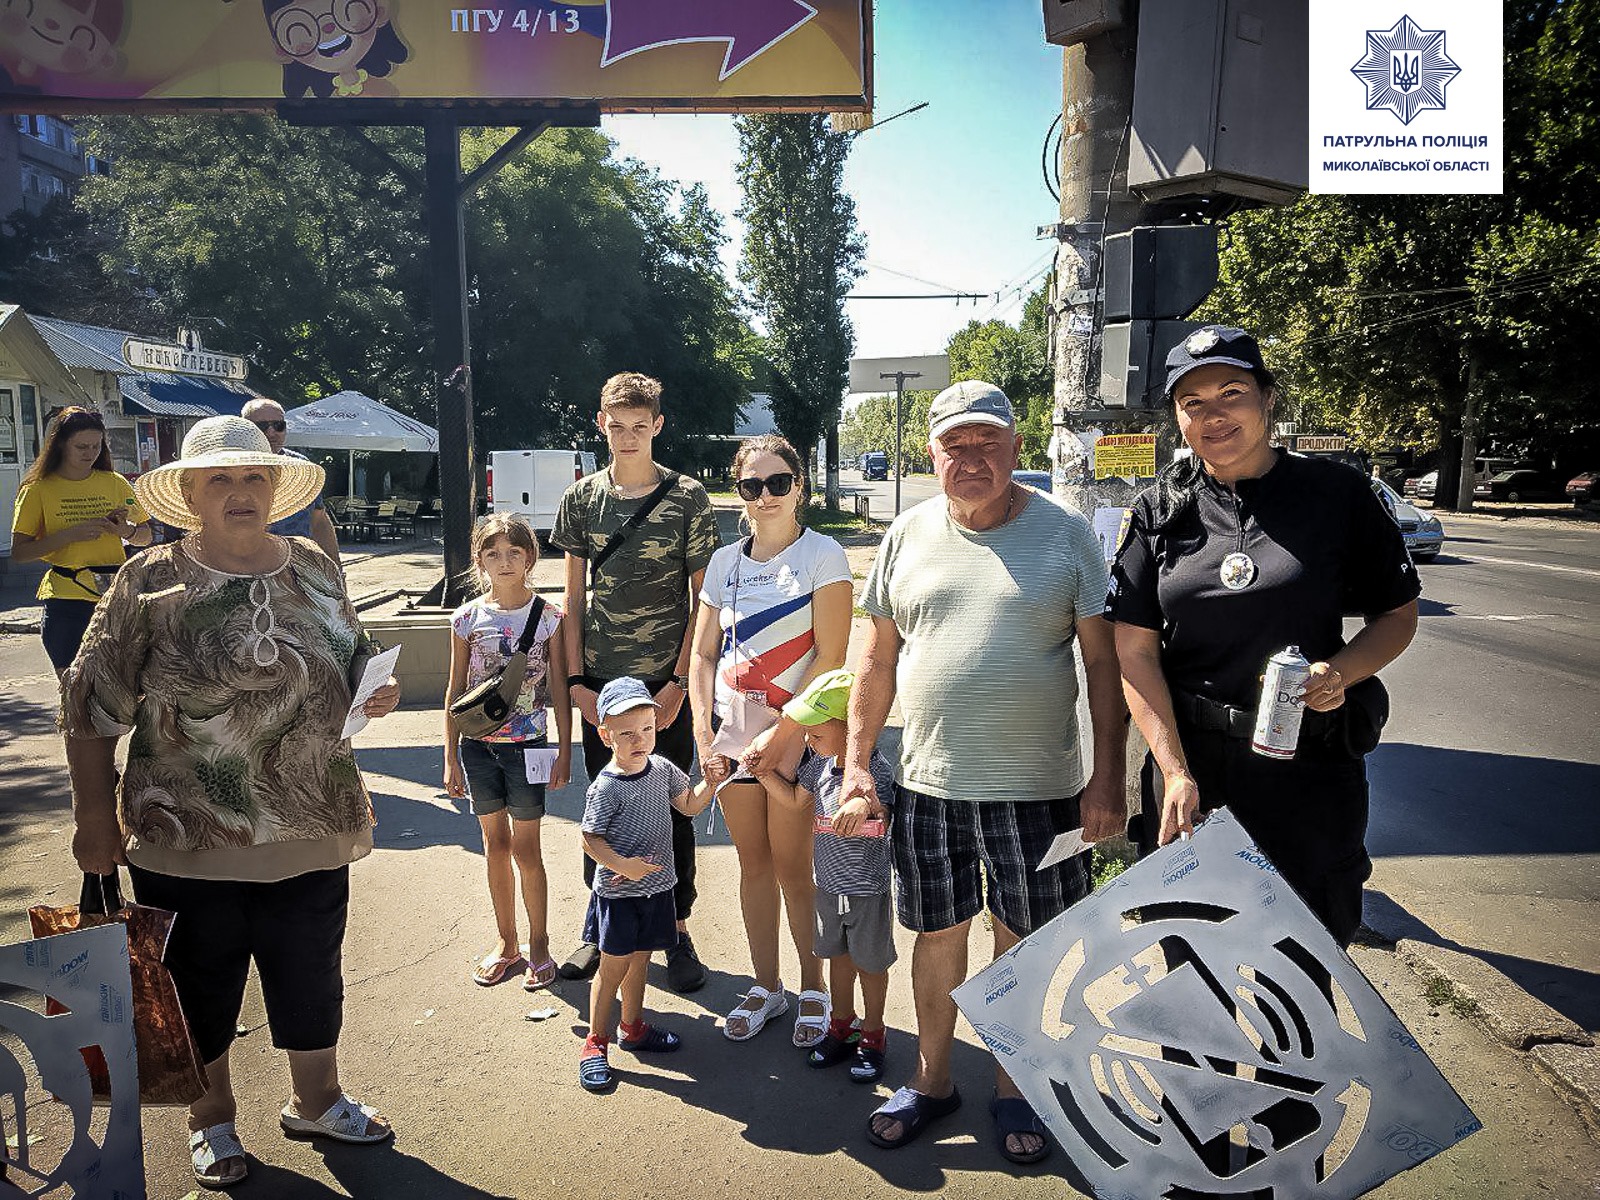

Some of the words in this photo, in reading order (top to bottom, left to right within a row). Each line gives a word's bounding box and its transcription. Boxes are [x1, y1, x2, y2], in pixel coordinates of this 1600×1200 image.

[450, 9, 504, 33] ПГУ
[511, 8, 581, 37] 4/13
[1297, 437, 1345, 451] ПРОДУКТИ
